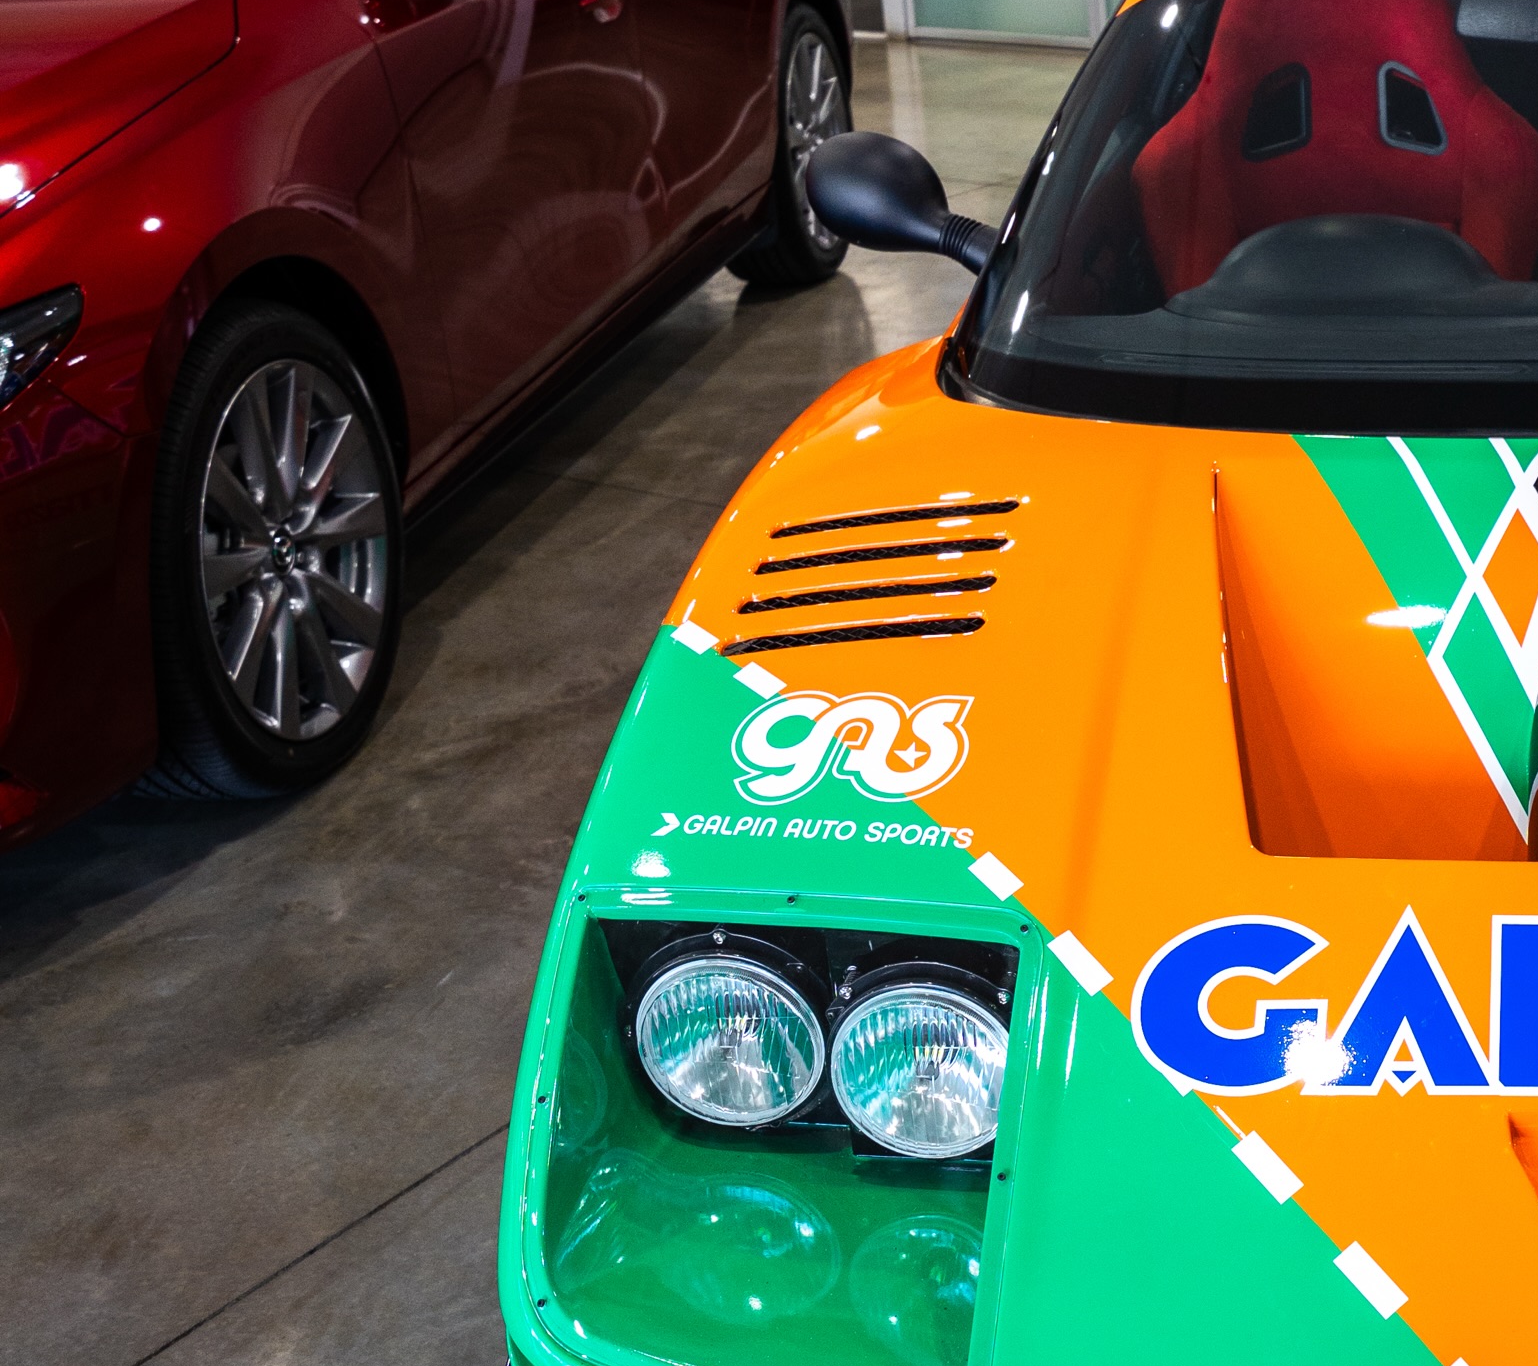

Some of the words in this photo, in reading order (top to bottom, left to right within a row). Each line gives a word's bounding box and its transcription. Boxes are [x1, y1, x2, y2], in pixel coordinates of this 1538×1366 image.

[683, 814, 778, 837] GALPIN
[783, 818, 857, 841] AUTO
[864, 821, 975, 850] SPORTS
